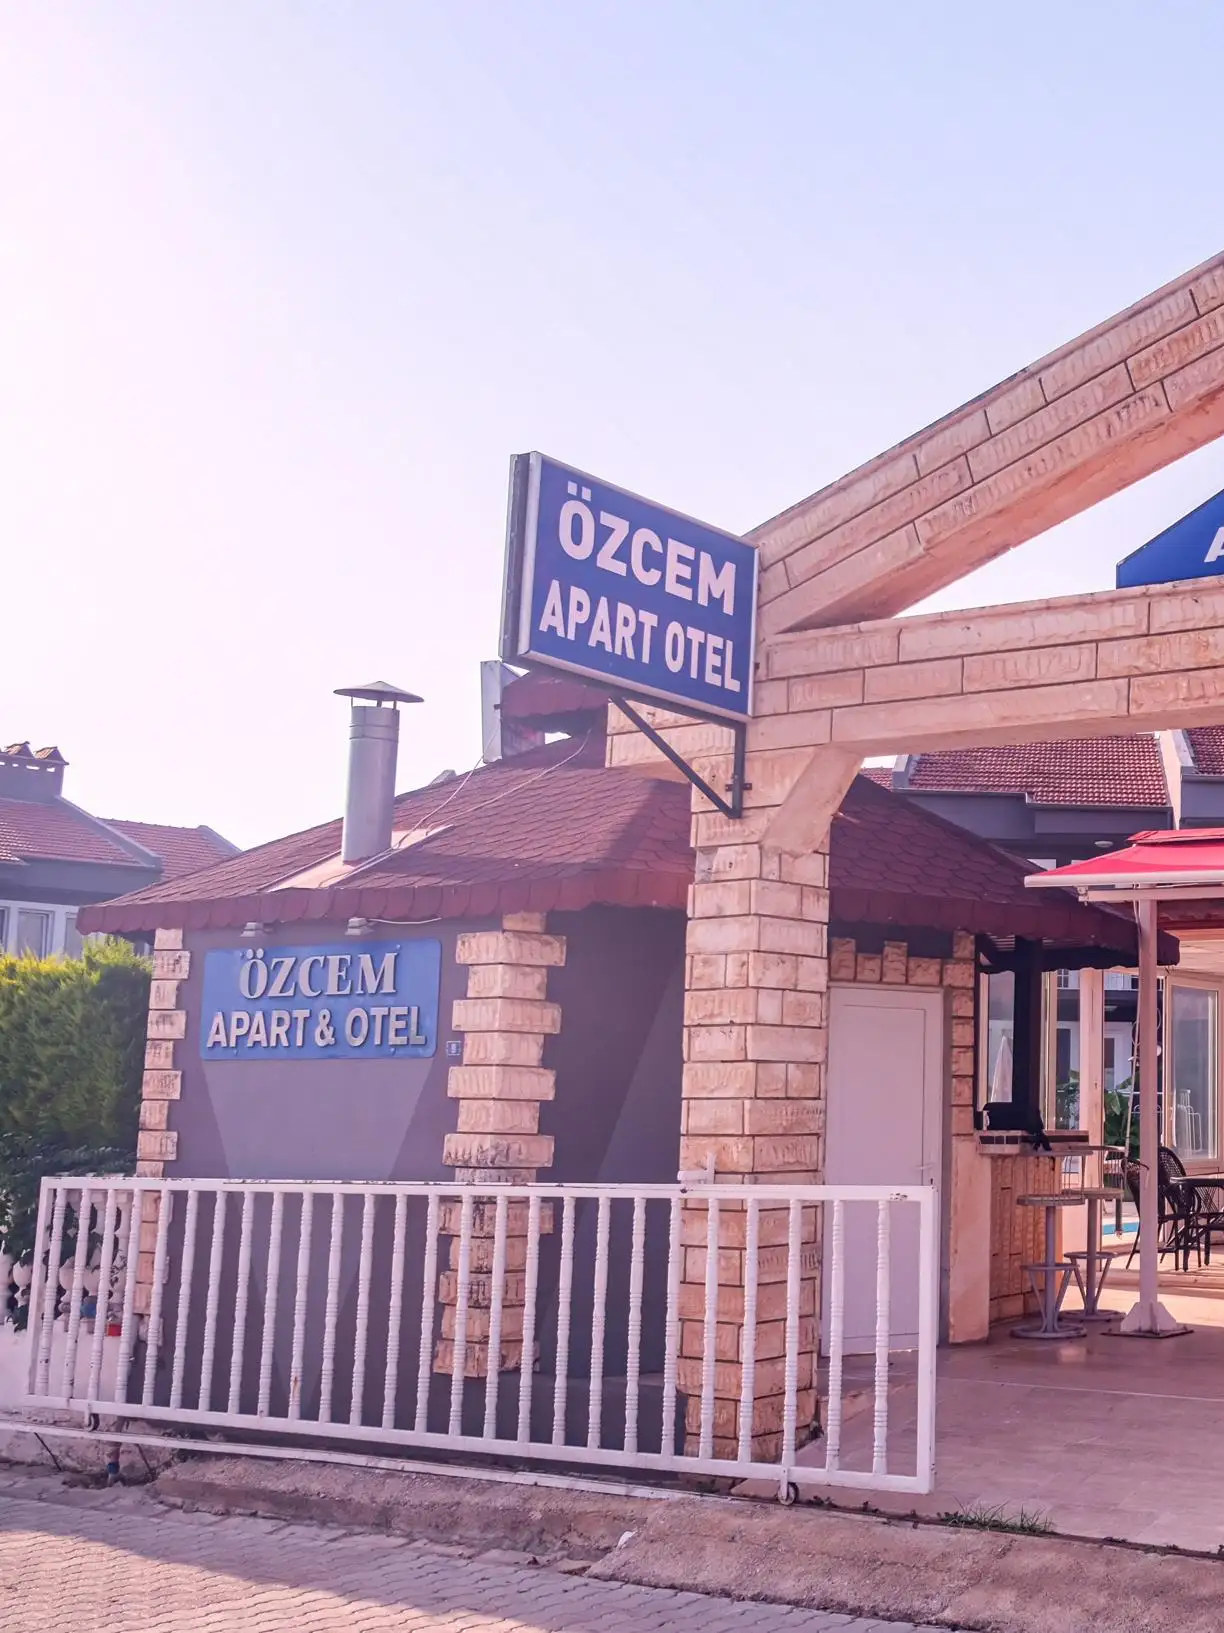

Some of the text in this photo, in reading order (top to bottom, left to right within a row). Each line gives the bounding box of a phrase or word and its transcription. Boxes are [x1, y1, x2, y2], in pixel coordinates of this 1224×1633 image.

[558, 480, 737, 616] ÖZCEM
[538, 579, 741, 693] APART OTEL
[238, 948, 399, 1000] ÖZCEM
[206, 1006, 427, 1049] APART & OTEL
